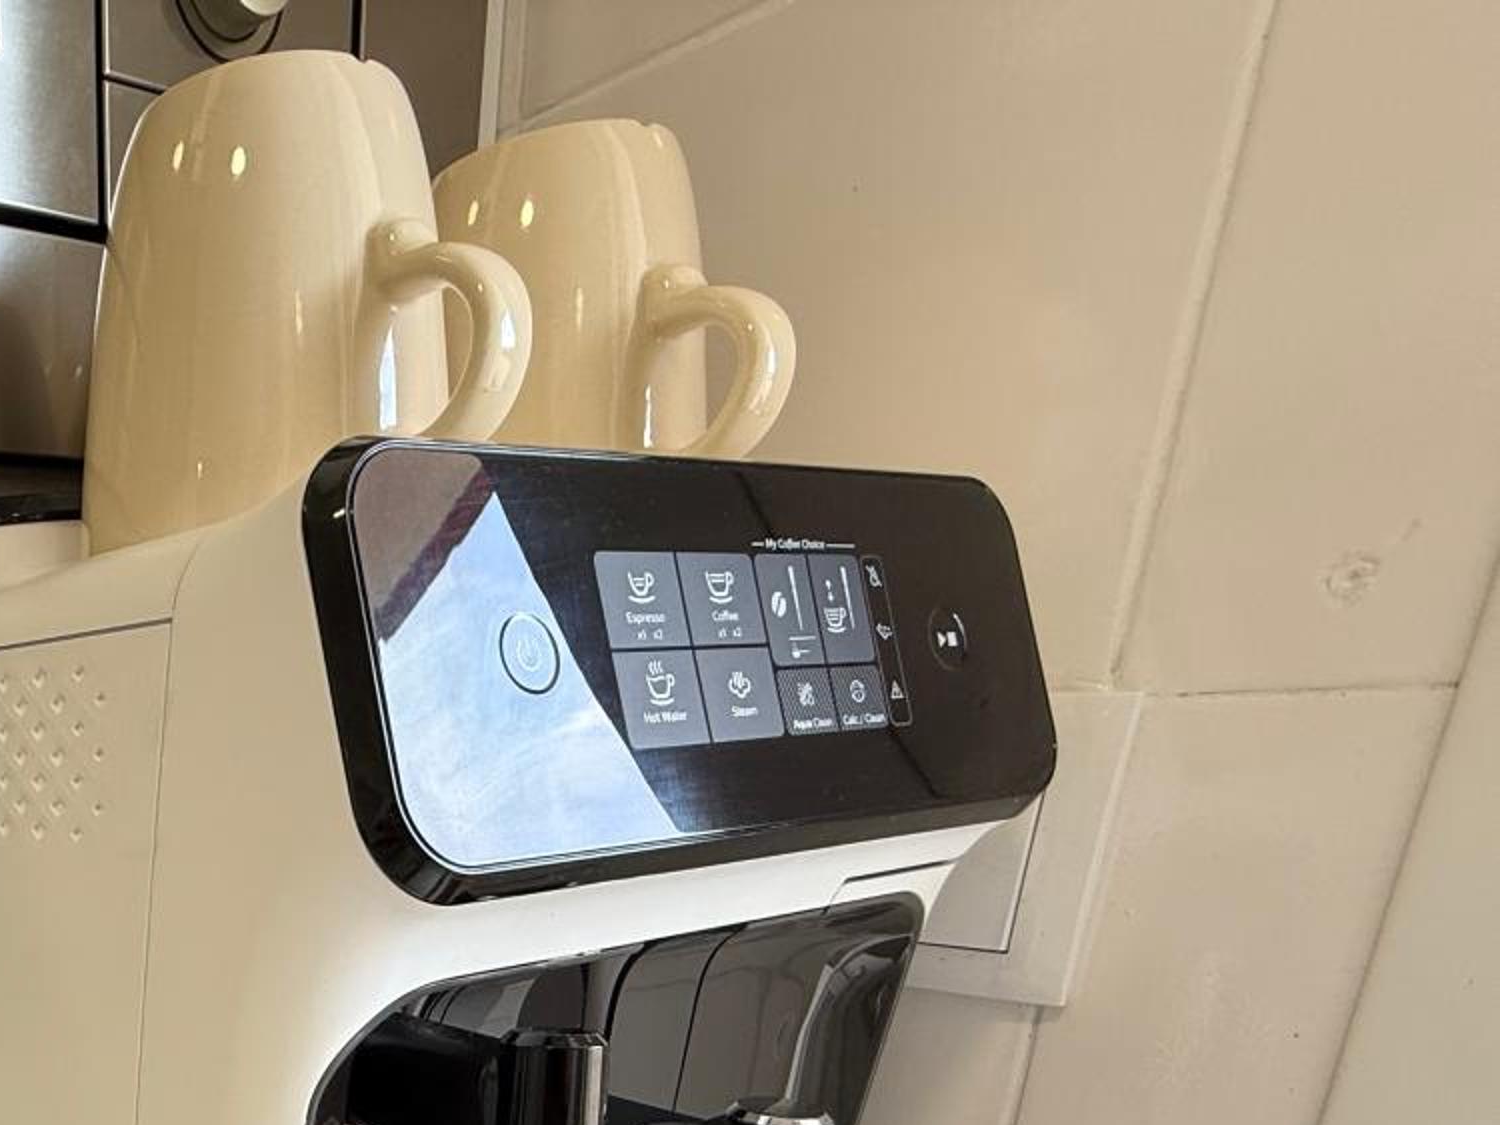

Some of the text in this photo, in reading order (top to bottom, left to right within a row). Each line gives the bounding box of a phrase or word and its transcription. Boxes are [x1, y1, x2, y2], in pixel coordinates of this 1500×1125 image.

[626, 611, 666, 624] Espresso
[712, 609, 739, 621] Coffee
[643, 711, 687, 724] Hot Water
[731, 705, 758, 718] Steam
